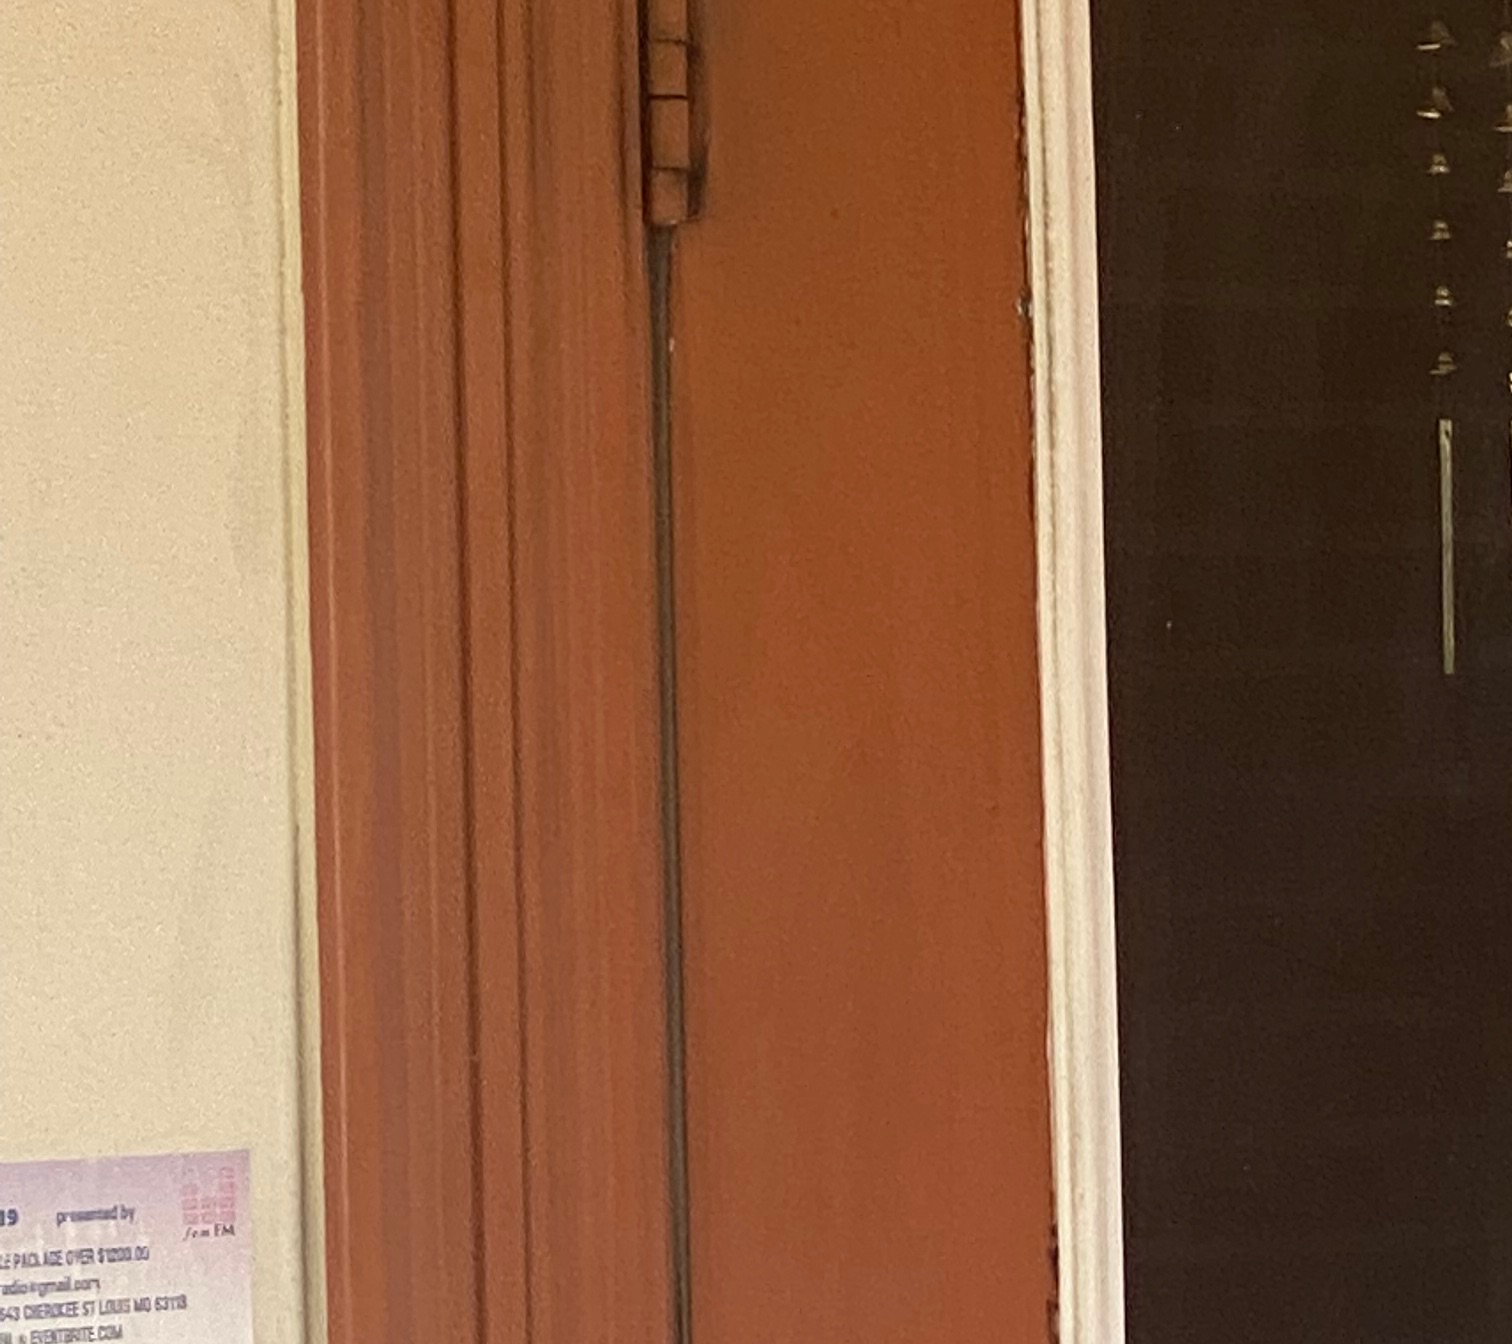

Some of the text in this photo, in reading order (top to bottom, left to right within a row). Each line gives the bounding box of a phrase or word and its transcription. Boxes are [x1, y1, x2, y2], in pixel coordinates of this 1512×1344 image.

[120, 1204, 136, 1224] by
[23, 1301, 79, 1321] CHEROKEE
[99, 1297, 131, 1316] LOUIS
